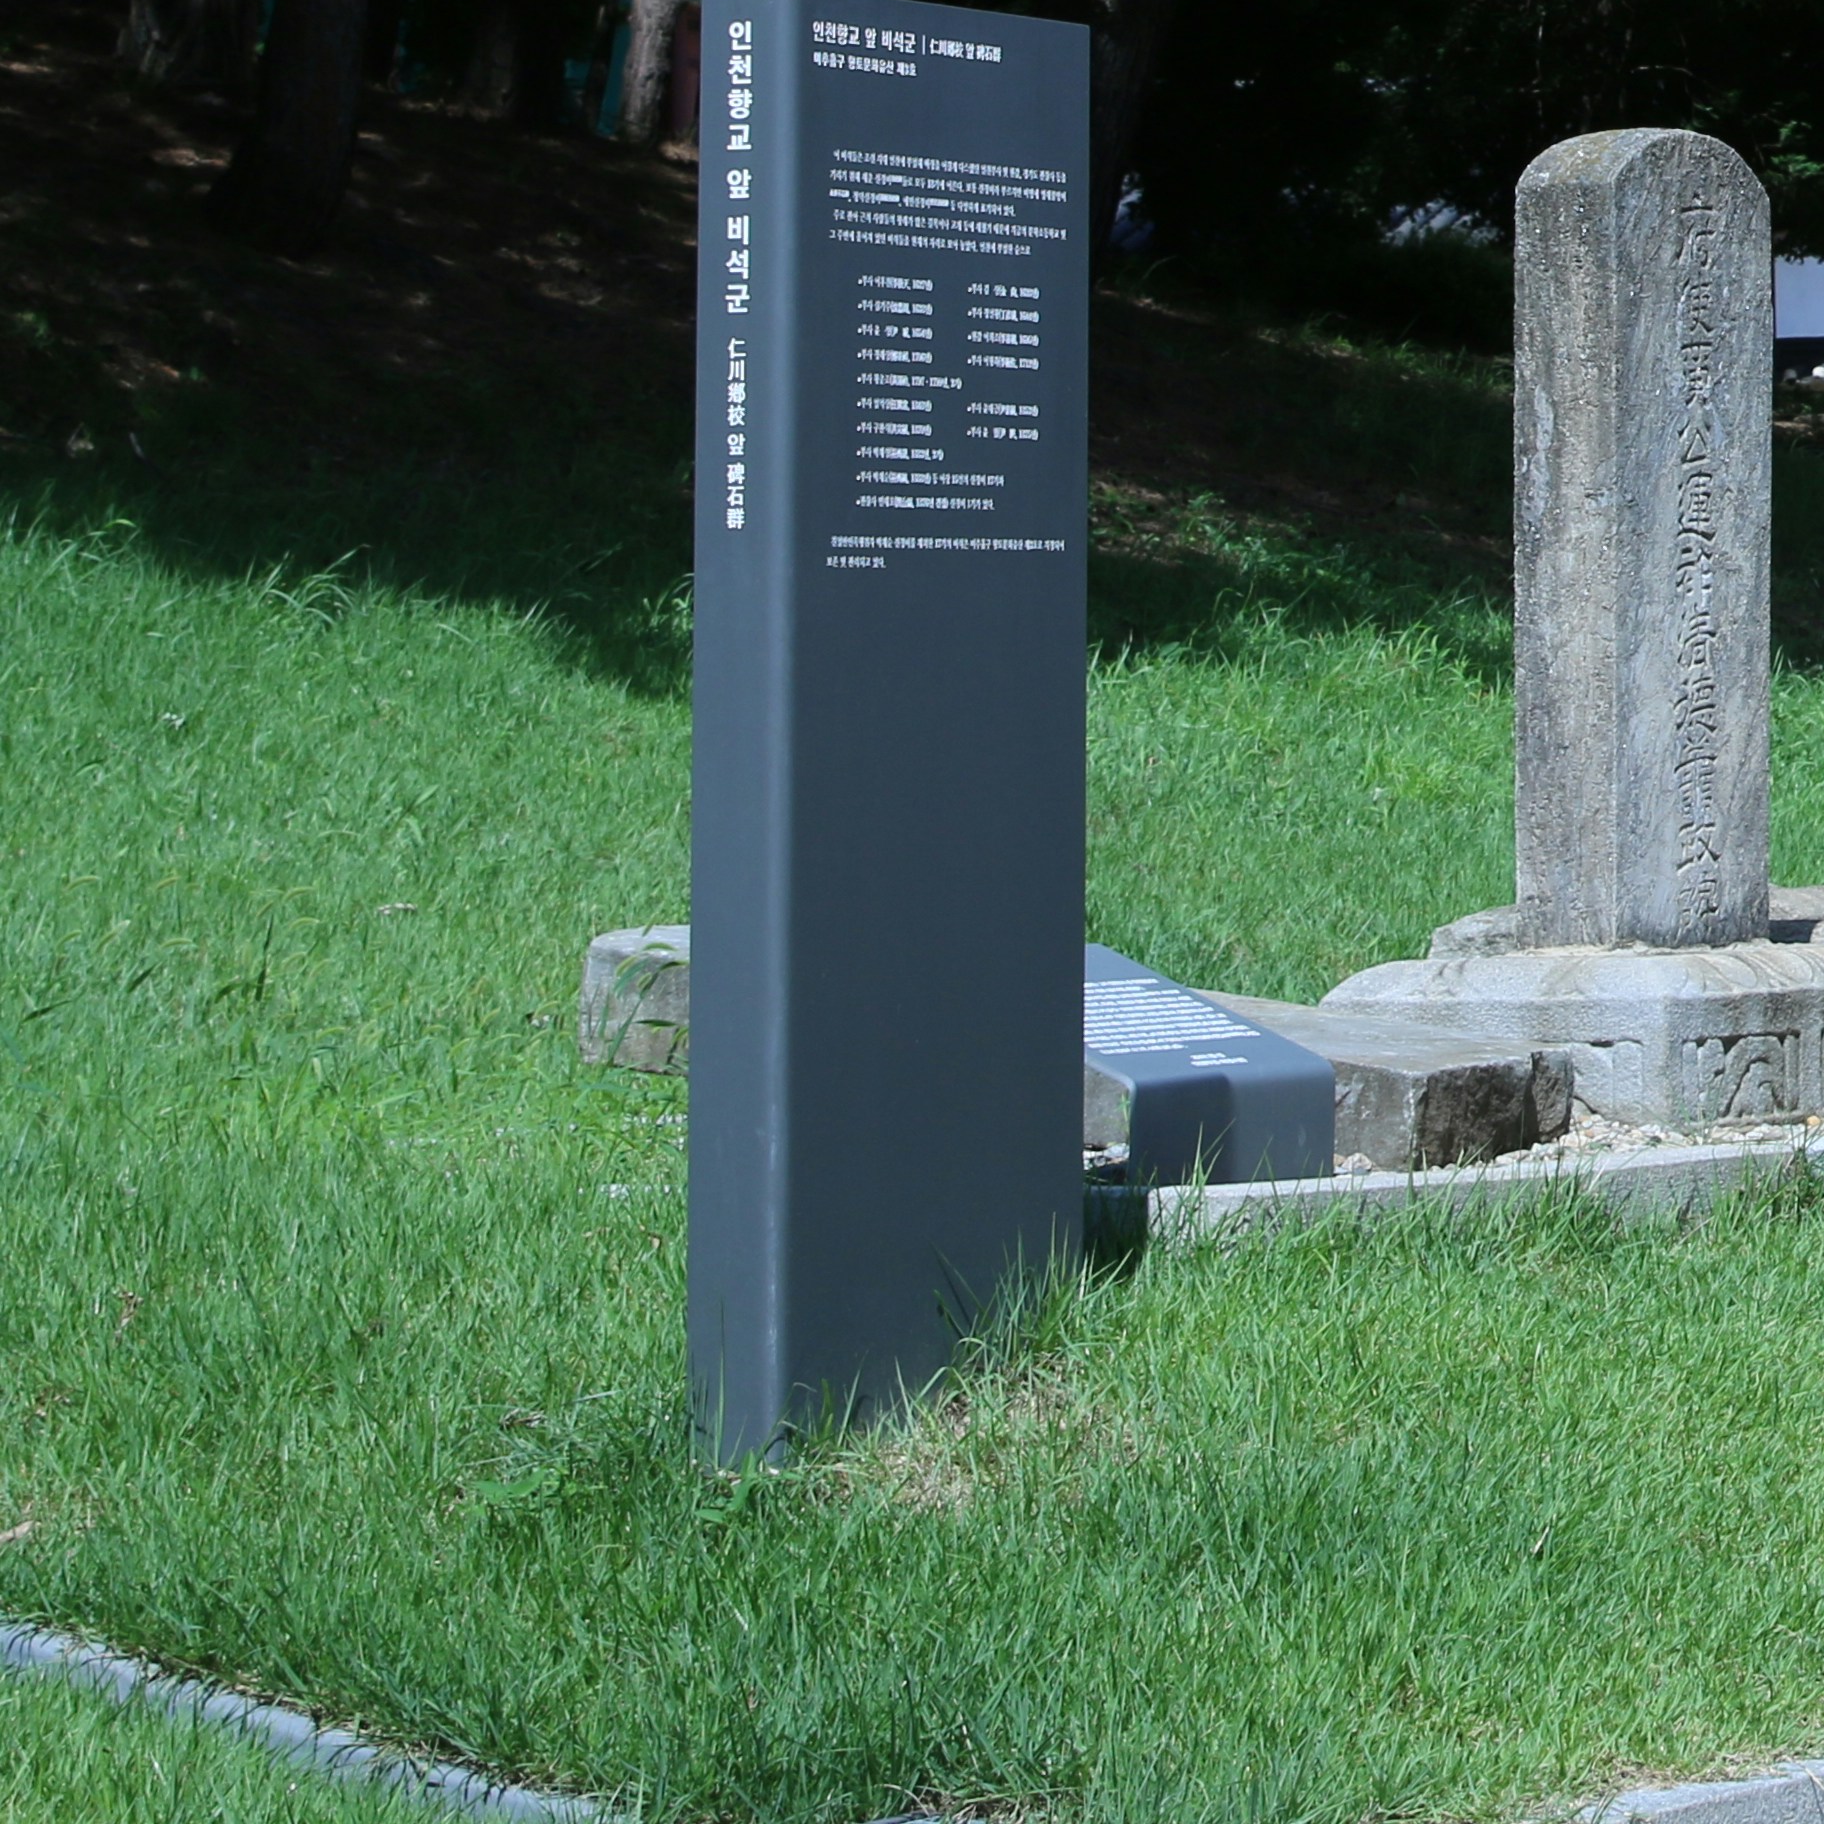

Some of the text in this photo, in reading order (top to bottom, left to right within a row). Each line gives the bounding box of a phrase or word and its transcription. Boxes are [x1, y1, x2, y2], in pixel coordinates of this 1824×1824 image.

[812, 20, 861, 45] 인천향교
[865, 27, 877, 49] 앞
[881, 30, 917, 55] 비석군
[726, 20, 753, 151] 인천향교
[726, 169, 752, 199] 앞
[725, 215, 751, 314] 비석군
[726, 433, 746, 456] 앞
